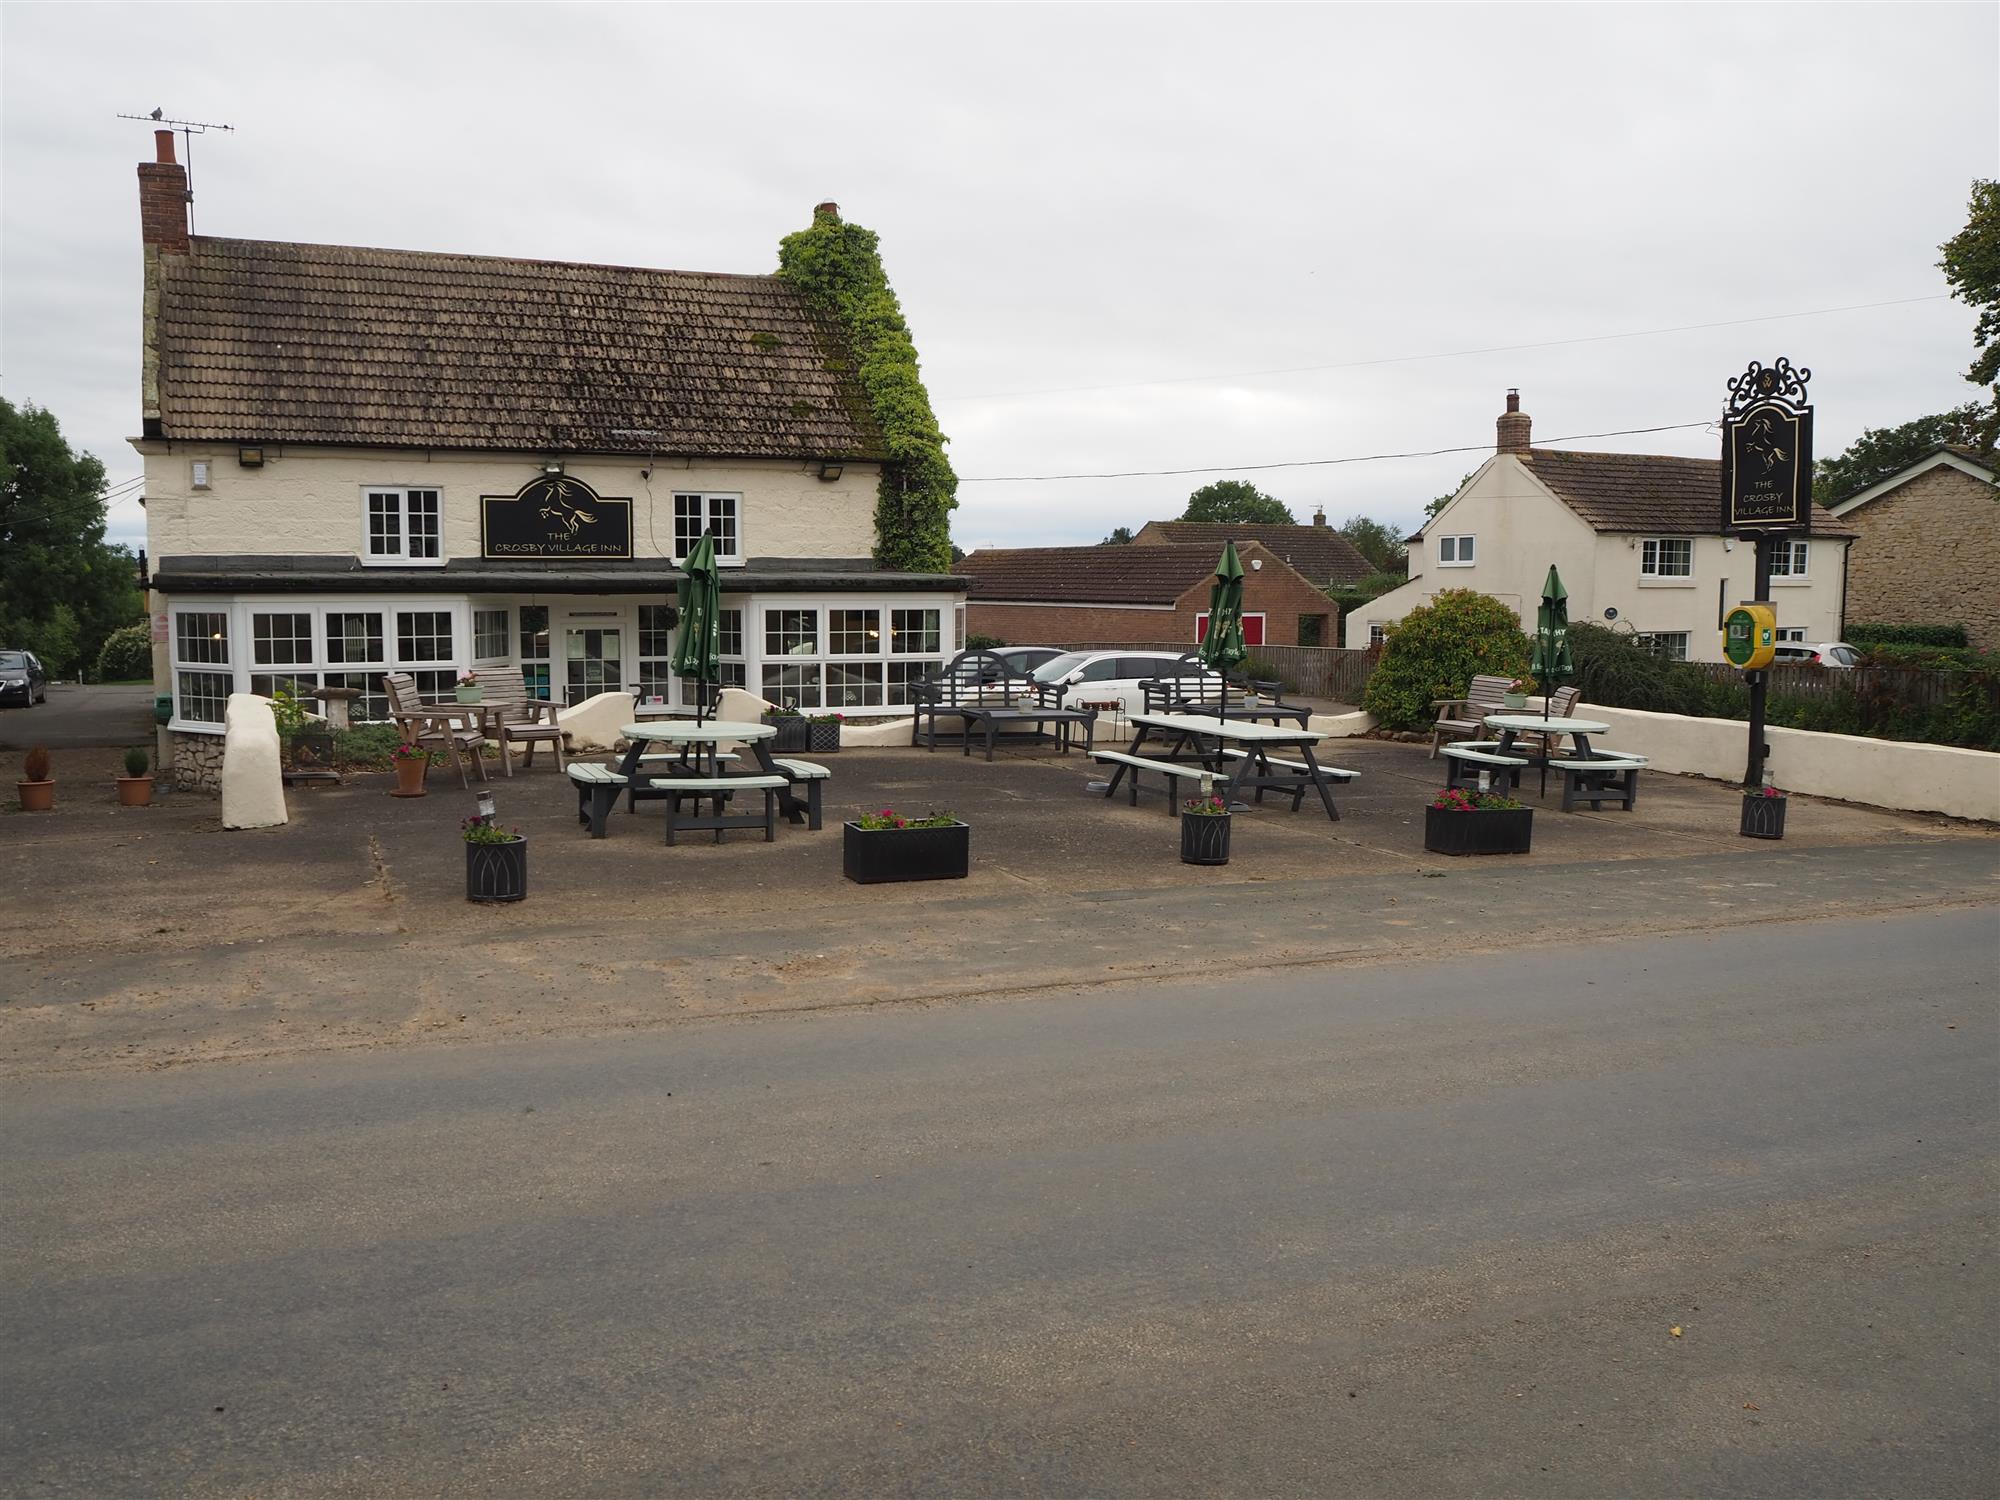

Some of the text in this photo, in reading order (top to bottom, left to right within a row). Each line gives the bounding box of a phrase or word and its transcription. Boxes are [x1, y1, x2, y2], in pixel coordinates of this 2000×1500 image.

[1754, 480, 1774, 489] THE
[1743, 492, 1784, 503] CROSBY
[1734, 505, 1794, 516] VILLAGE INN
[547, 532, 571, 541] THE
[495, 543, 622, 555] CROSBY VILLAGE INN
